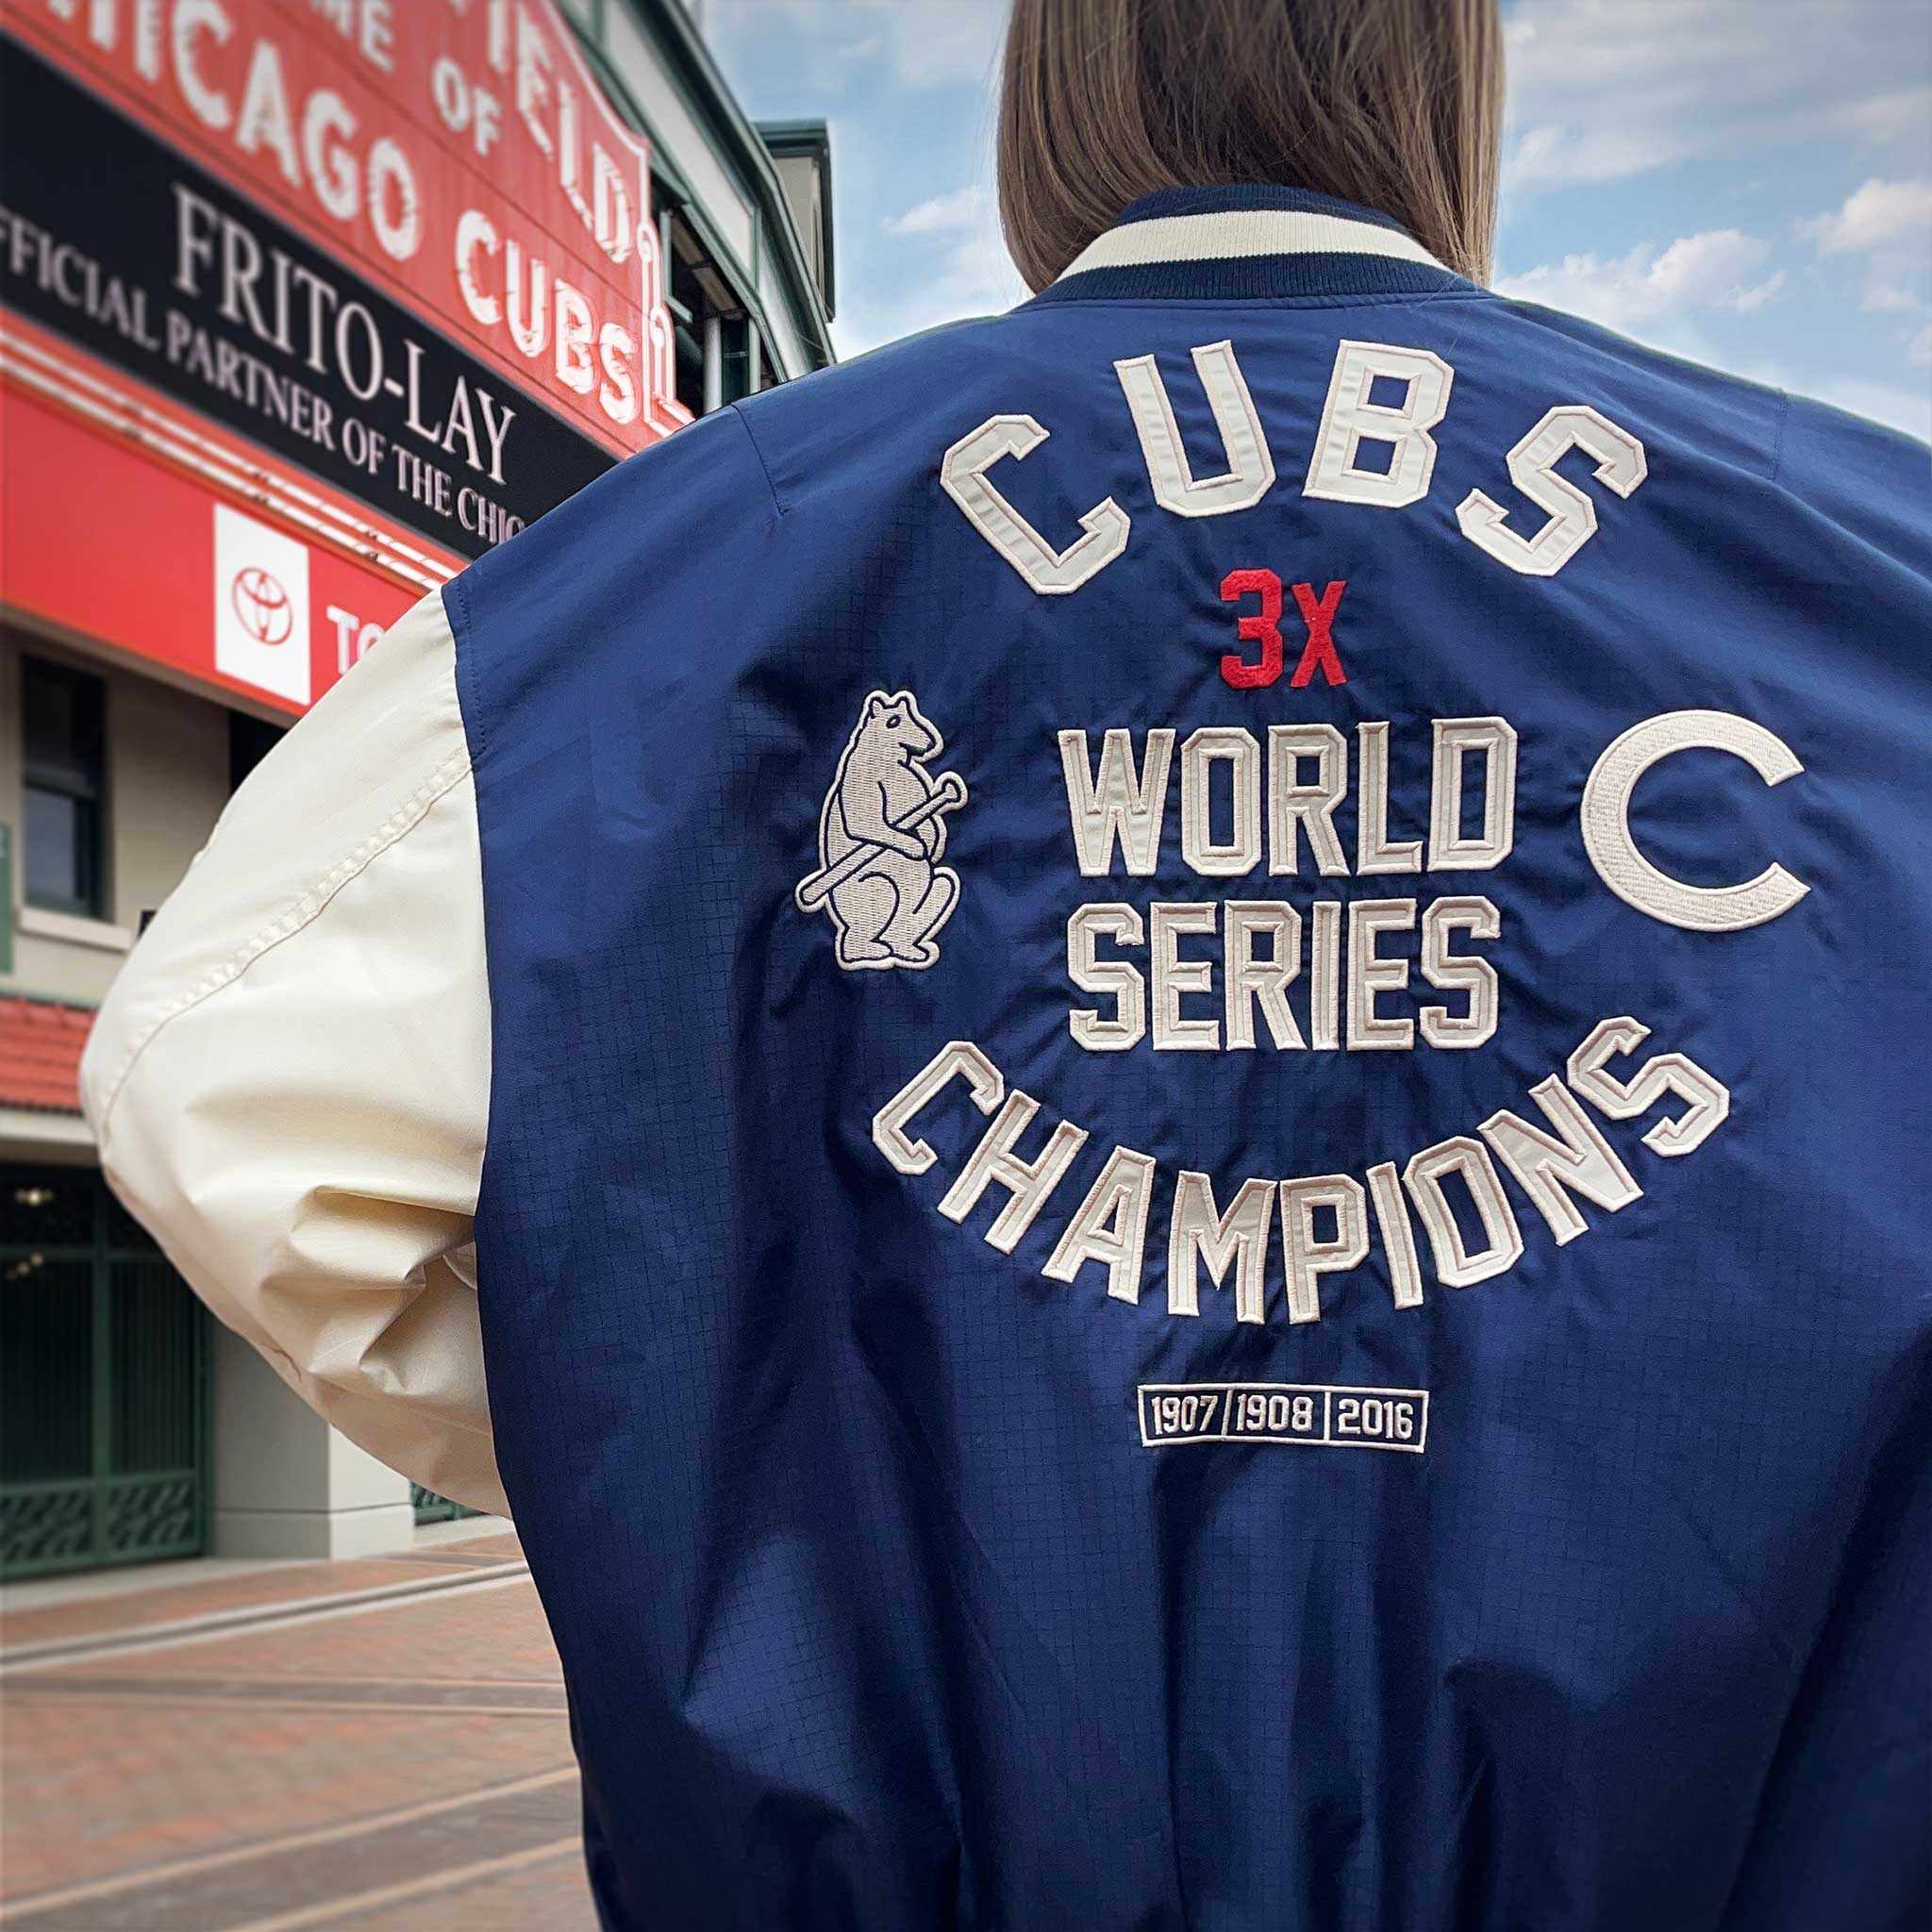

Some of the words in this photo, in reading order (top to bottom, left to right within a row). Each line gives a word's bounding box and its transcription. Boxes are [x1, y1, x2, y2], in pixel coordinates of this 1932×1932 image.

[432, 57, 502, 158] OF
[449, 0, 634, 263] IELD
[166, 306, 336, 453] PARTNER
[341, 417, 387, 475] OF
[391, 443, 453, 518] THE
[172, 182, 518, 486] FRITO-LAY
[456, 208, 638, 425] CUBS
[941, 340, 1647, 594] CUBS
[1221, 569, 1345, 688] 3X
[1058, 716, 1518, 877] WORLD
[1580, 709, 1811, 932] C
[1067, 896, 1502, 1052] SERIES
[872, 1015, 1731, 1325] CHAMPIONS
[1151, 1394, 1219, 1436] 1907
[1236, 1393, 1314, 1431] 1908
[1338, 1398, 1414, 1440] 2016
